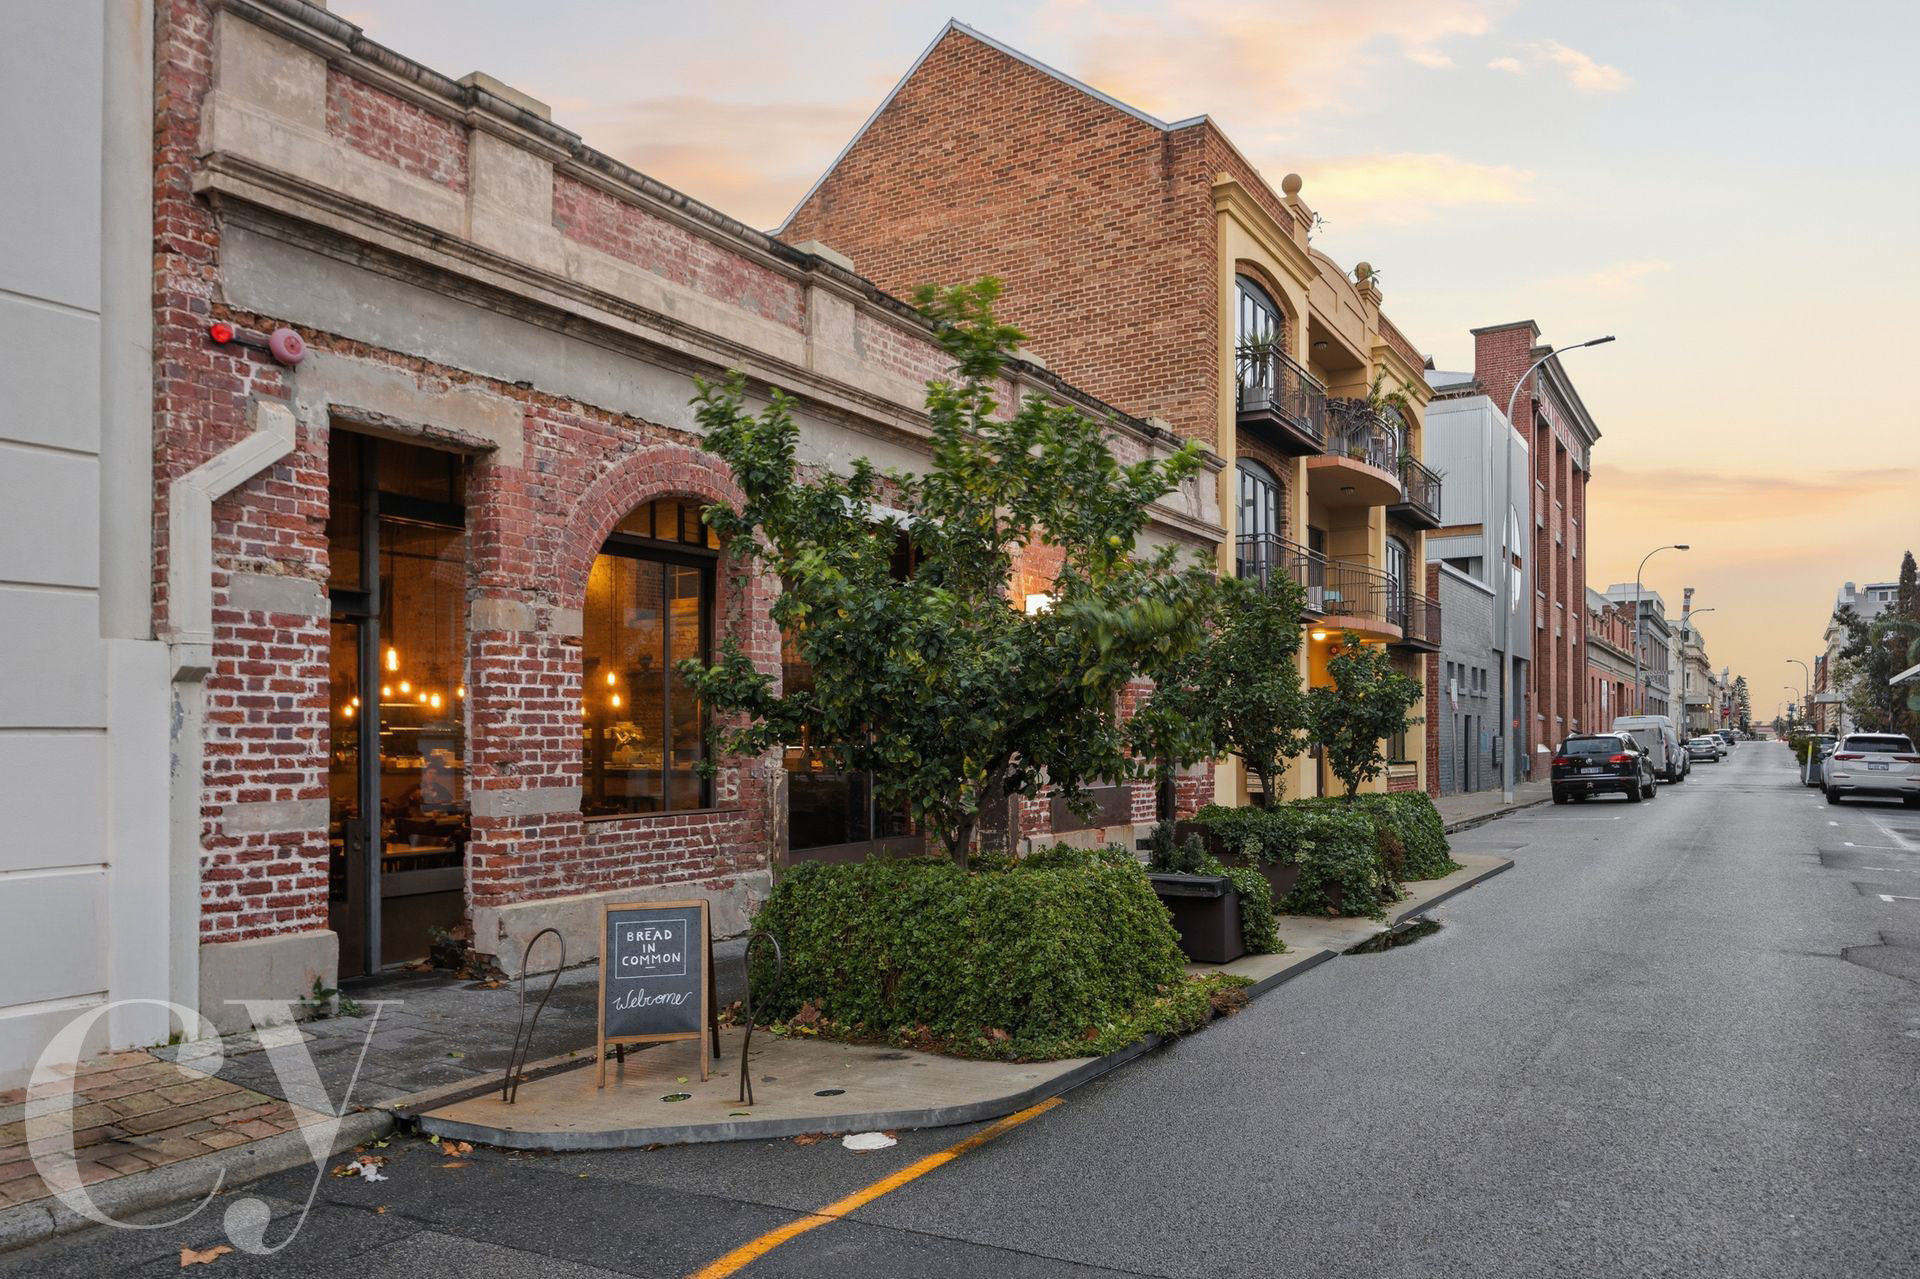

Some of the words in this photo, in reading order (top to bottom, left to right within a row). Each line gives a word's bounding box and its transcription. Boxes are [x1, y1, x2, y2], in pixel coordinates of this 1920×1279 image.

[627, 930, 672, 942] BREAD
[642, 943, 656, 953] IN
[622, 952, 681, 966] COMMON
[612, 988, 693, 1010] Welcome
